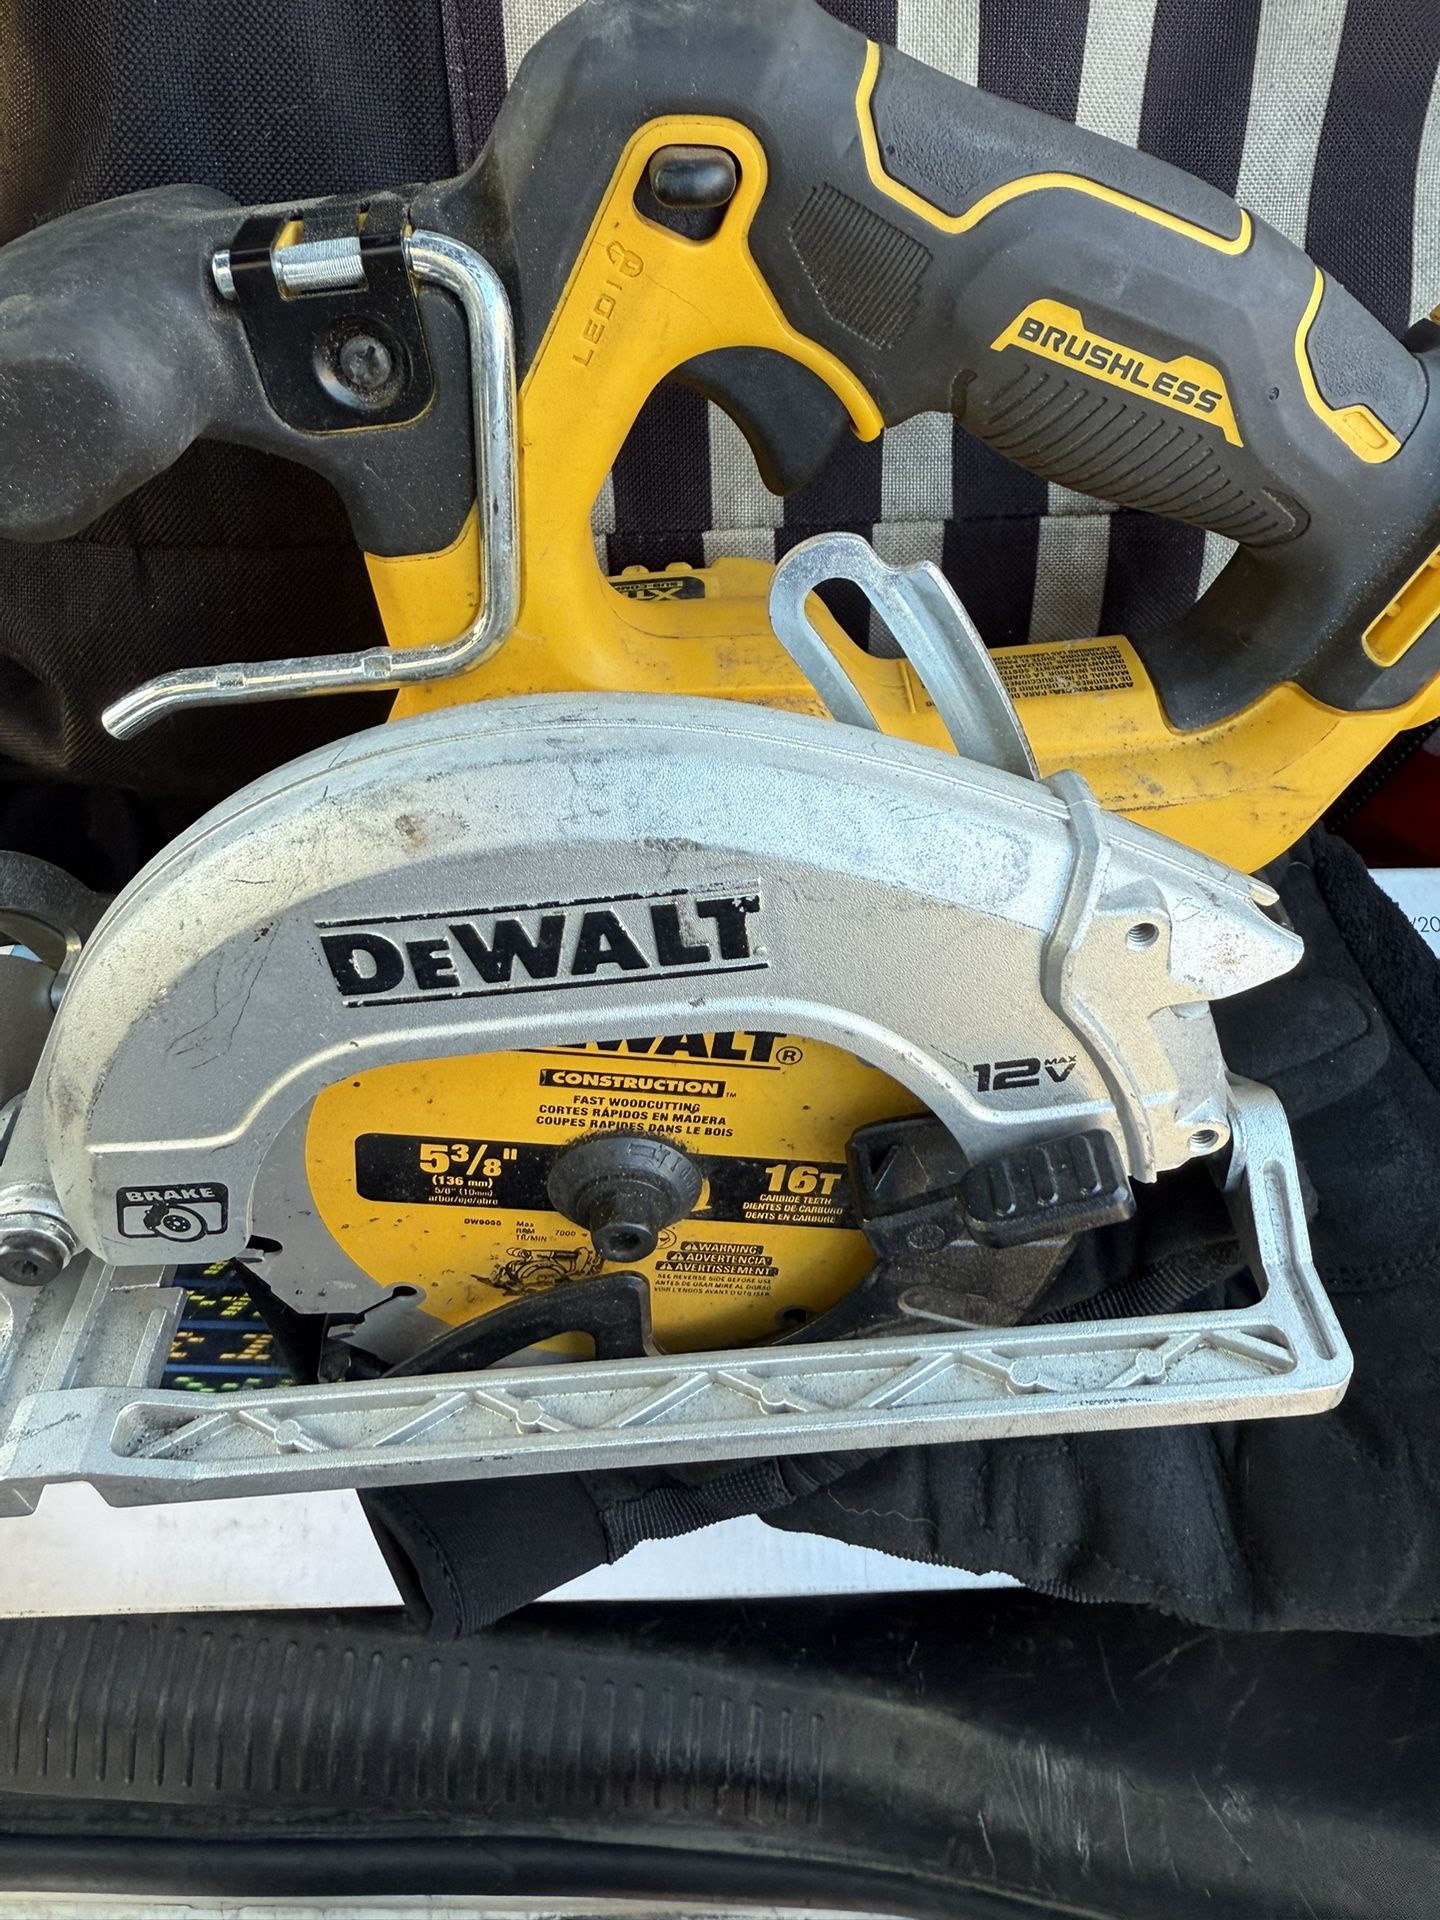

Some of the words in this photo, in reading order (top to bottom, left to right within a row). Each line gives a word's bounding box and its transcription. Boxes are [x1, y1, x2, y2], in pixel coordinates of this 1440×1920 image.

[1017, 317, 1222, 413] BRUSHLESS
[1044, 1055, 1077, 1065] MAX
[552, 1071, 719, 1095] CONSTRUCTION
[574, 1095, 606, 1106] FAST
[609, 1097, 701, 1113] WOODCUTTING
[539, 1104, 589, 1116] CORTES
[592, 1106, 649, 1120] RÁPIDOS
[652, 1112, 669, 1122] EN
[672, 1113, 726, 1126] MADERA
[536, 1115, 586, 1127] COUPES
[590, 1118, 644, 1131] RAPIDES
[649, 1122, 683, 1134] DANS
[686, 1126, 701, 1135] LE
[704, 1127, 734, 1137] BOIS
[432, 1174, 464, 1186] (136
[467, 1177, 494, 1189] mm)
[765, 1164, 842, 1195] 16T
[125, 1187, 216, 1202] BRAKE
[759, 1193, 801, 1204] CARBIDE
[803, 1196, 832, 1205] TEETH
[742, 1202, 782, 1212] DIENTES
[784, 1204, 797, 1213] DE
[799, 1205, 844, 1215] CARBURO
[745, 1211, 776, 1220] DENTS
[778, 1213, 790, 1221] EN
[792, 1213, 836, 1224] CARBURE
[555, 1229, 577, 1237] 7000
